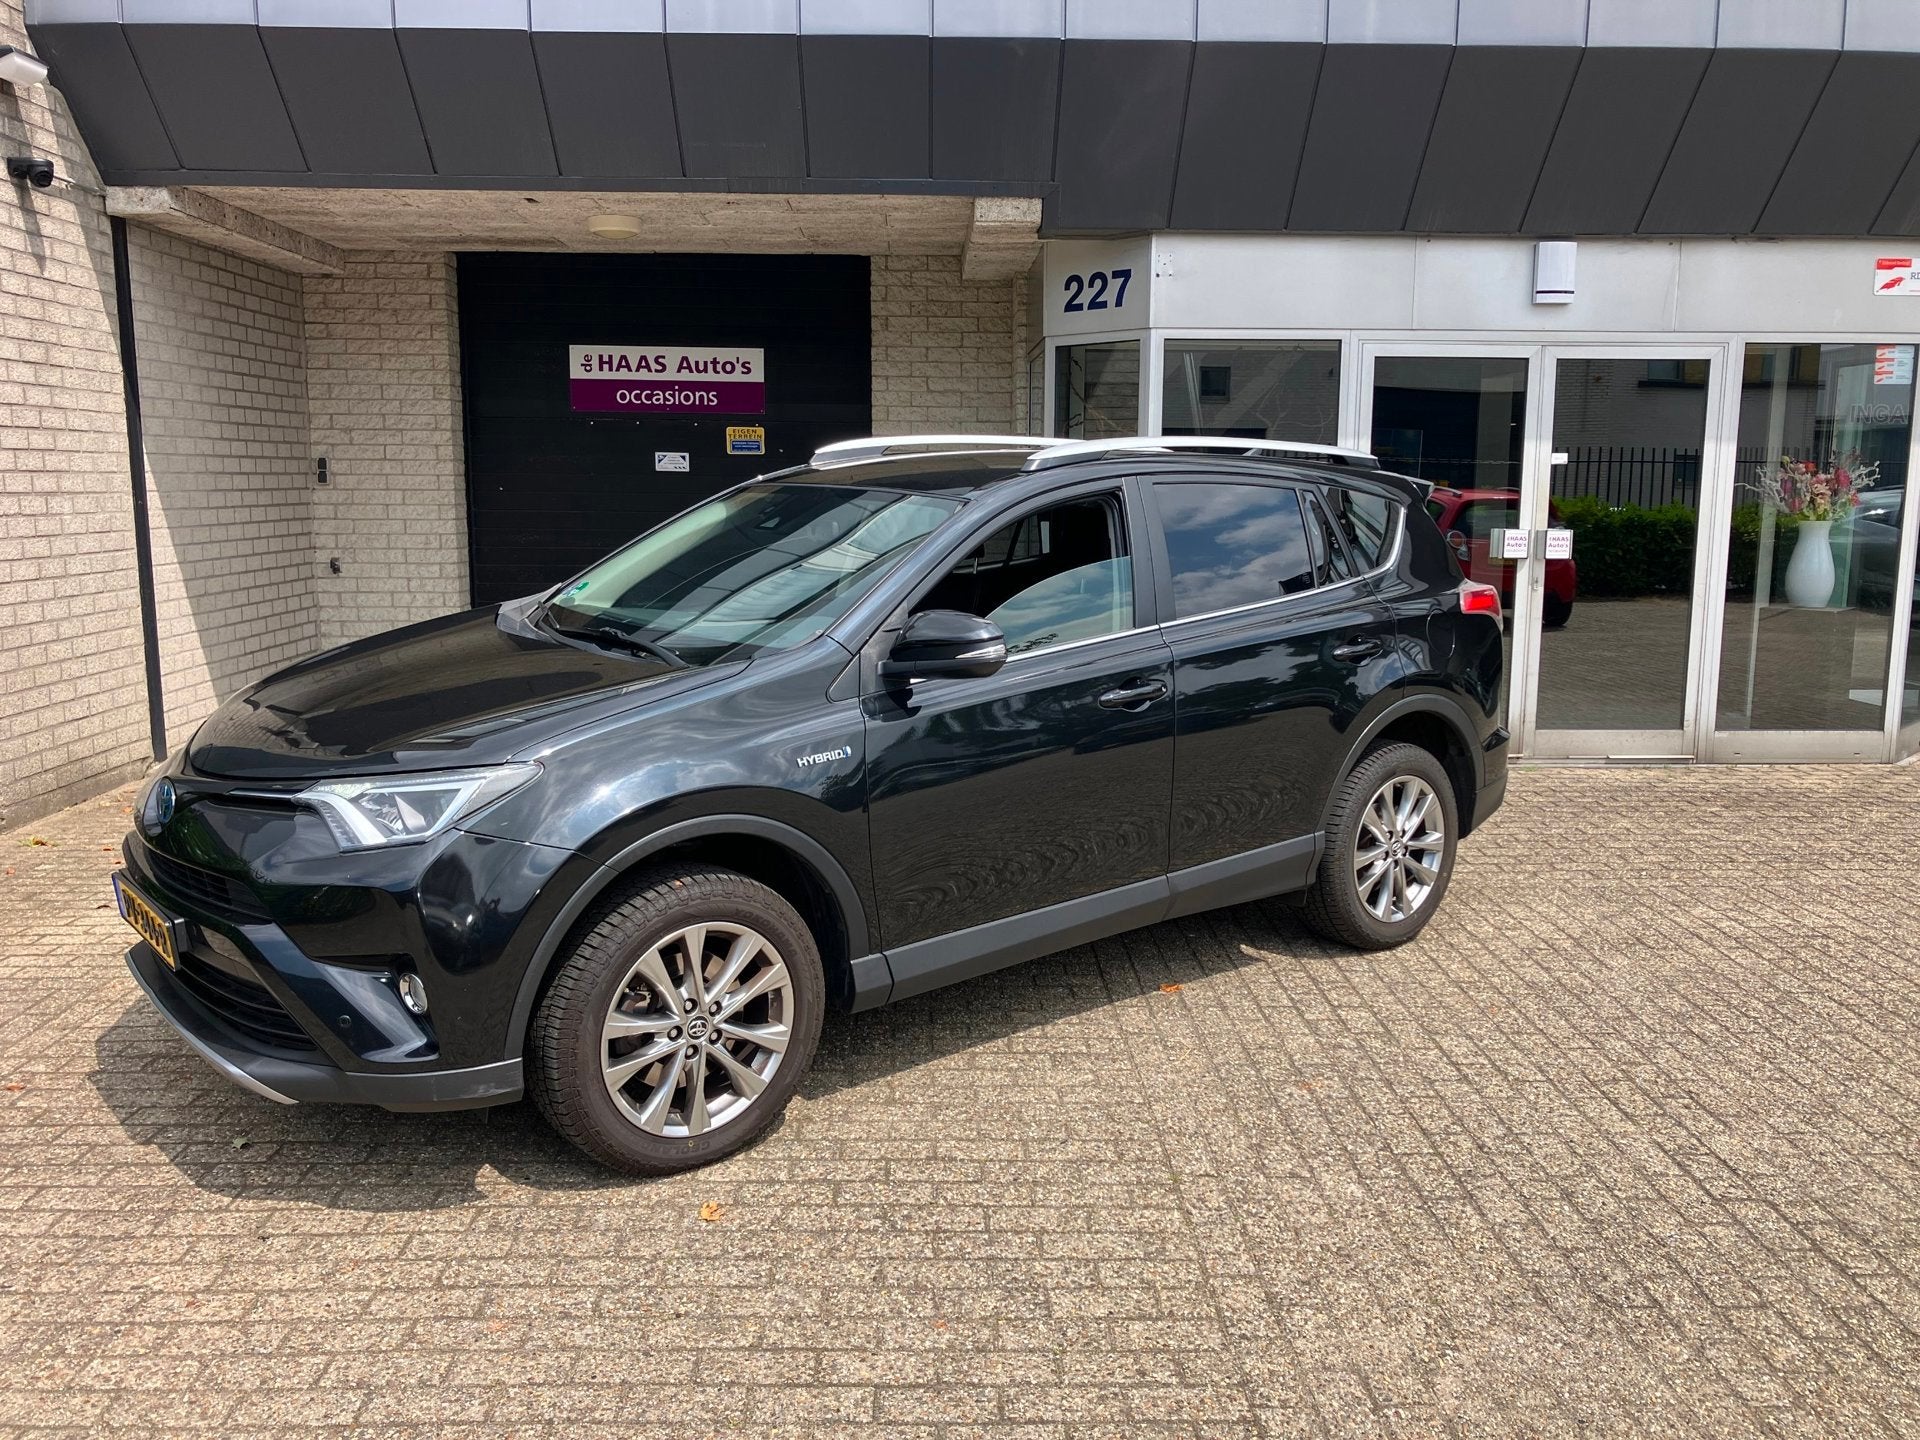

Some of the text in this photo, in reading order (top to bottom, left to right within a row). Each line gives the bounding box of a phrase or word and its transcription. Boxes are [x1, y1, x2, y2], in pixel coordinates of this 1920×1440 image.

[1064, 268, 1132, 313] 227
[581, 353, 752, 375] de HAAS Auto's
[616, 385, 718, 406] occasions
[796, 749, 844, 768] HYBRID
